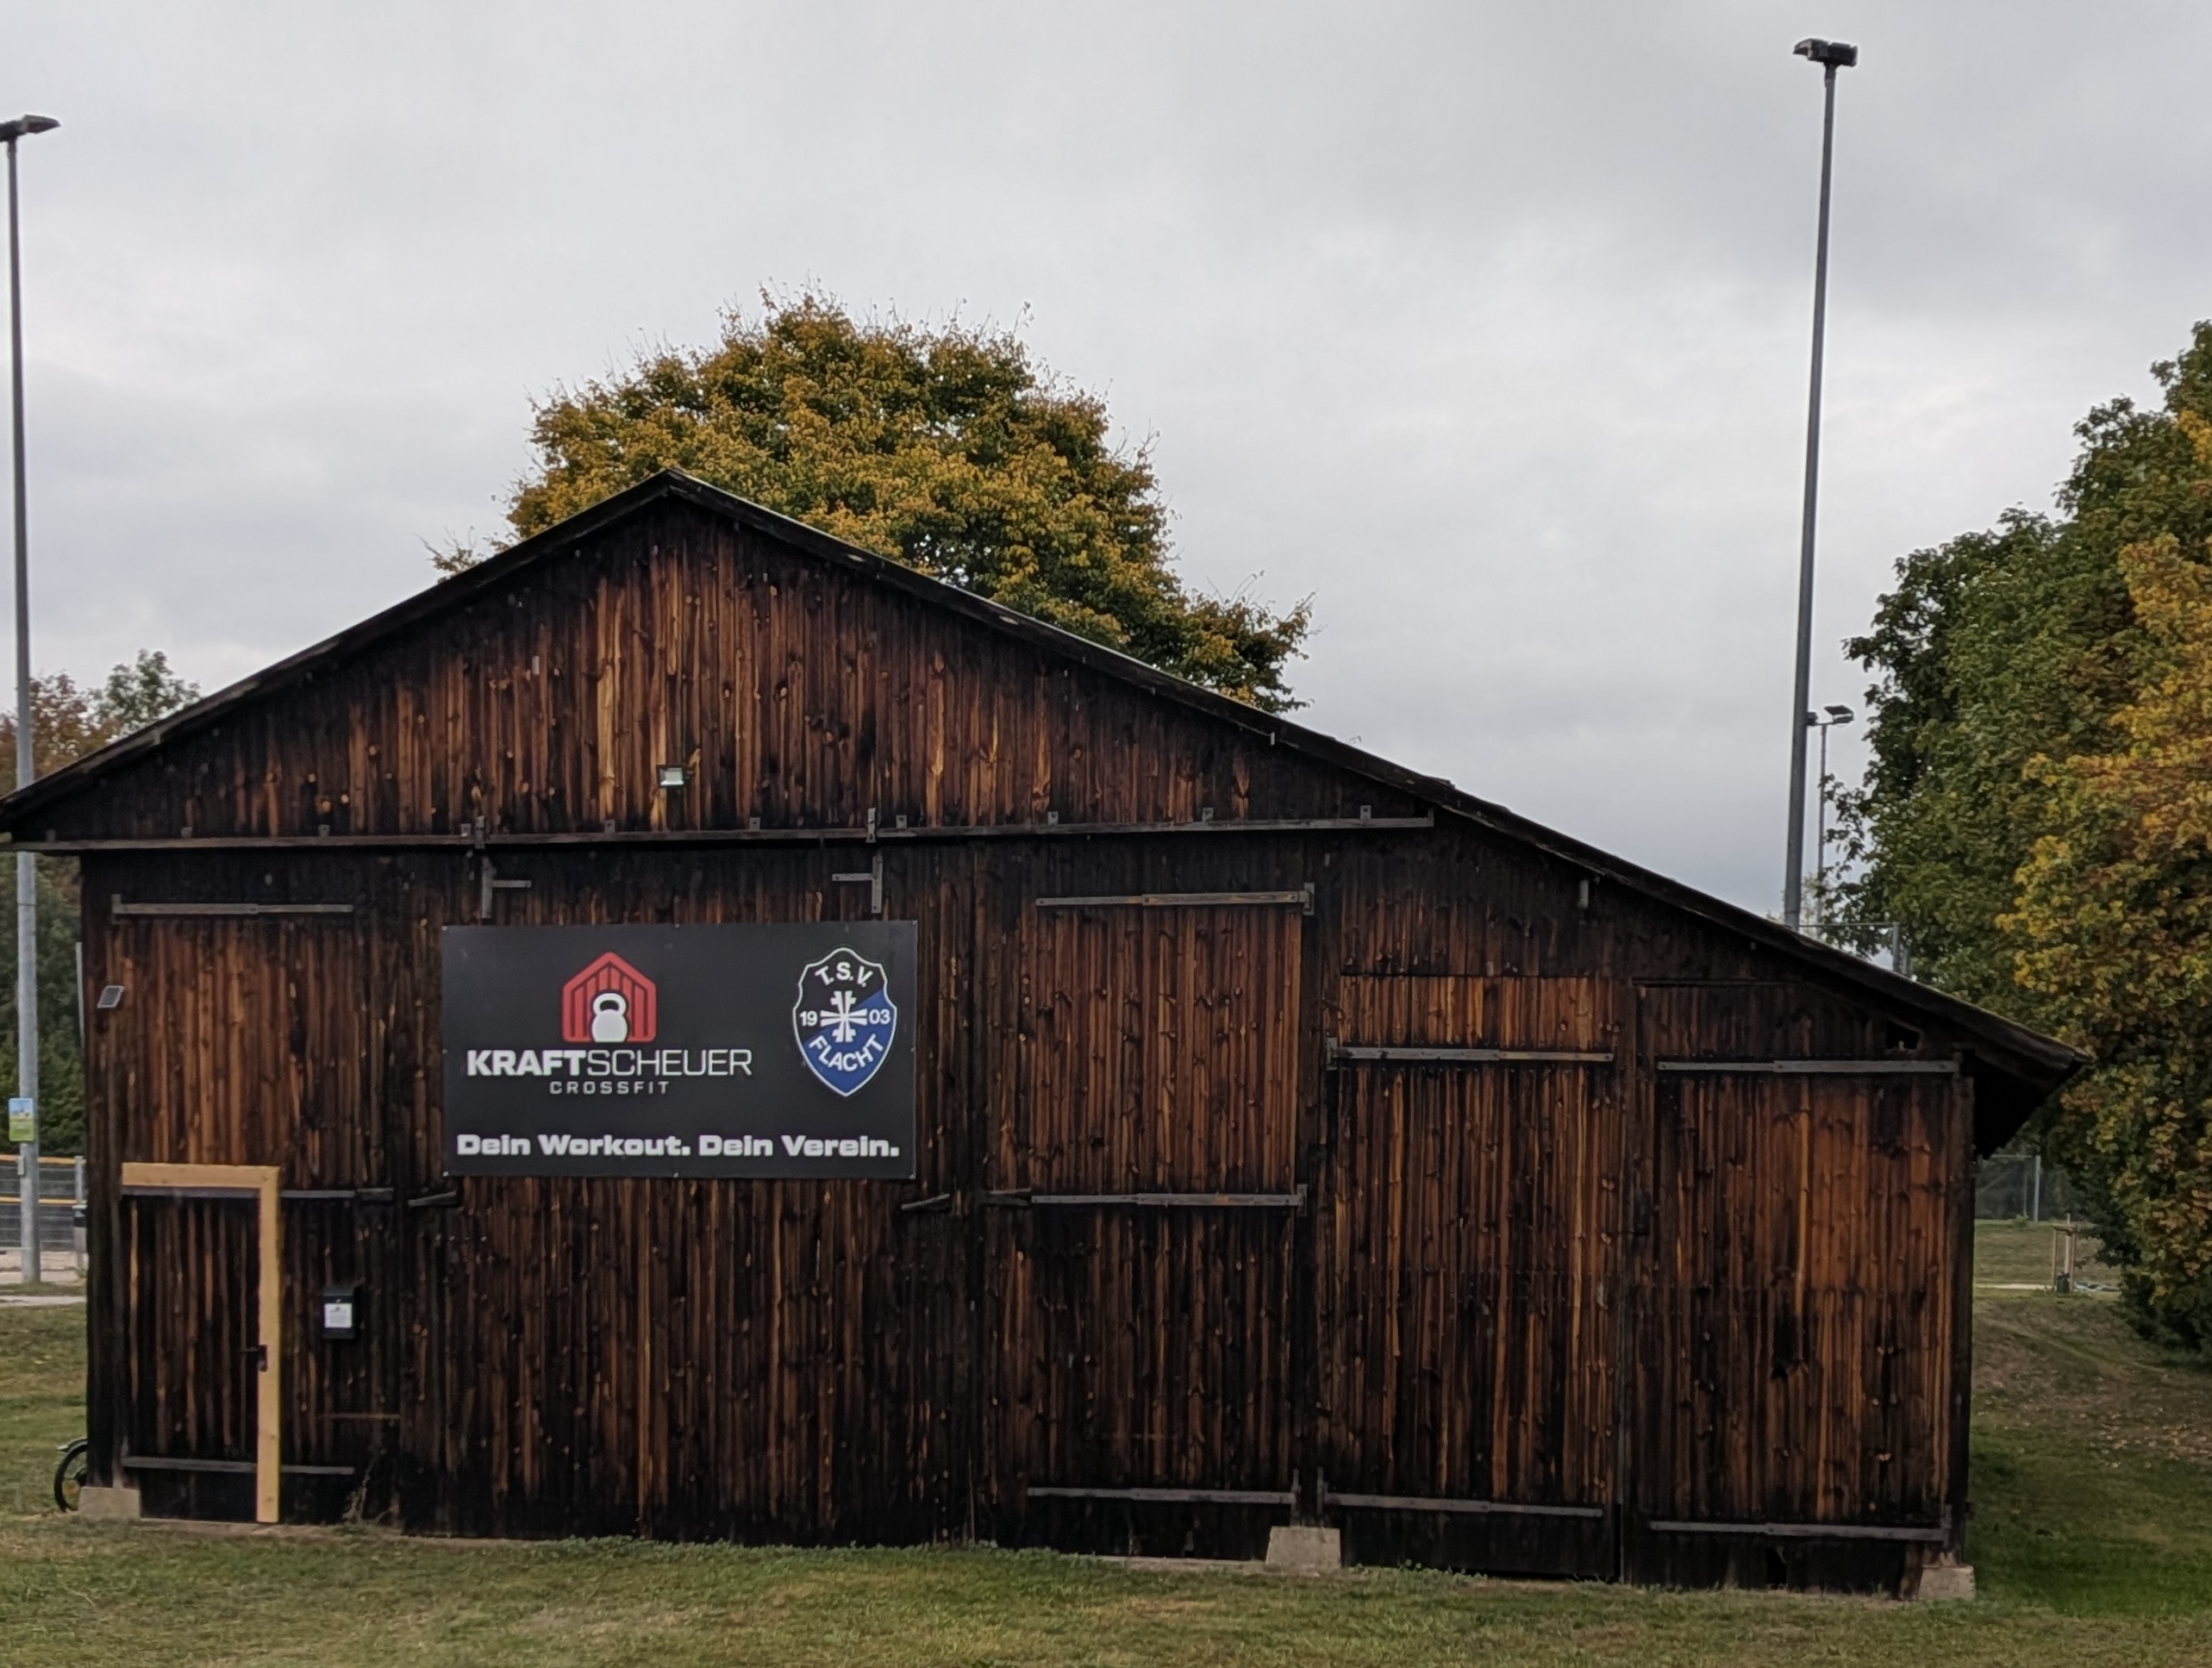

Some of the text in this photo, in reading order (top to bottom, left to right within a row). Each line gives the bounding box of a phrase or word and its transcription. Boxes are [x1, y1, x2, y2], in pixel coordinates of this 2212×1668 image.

[815, 962, 873, 987] T.S.V.
[800, 1009, 891, 1027] 19 03
[467, 1049, 753, 1077] KRAFTSCHEUER
[809, 1034, 884, 1071] FLACHT
[550, 1081, 669, 1094] CROSSFIT
[457, 1134, 899, 1157] Dein Workout. Dein Verein.
